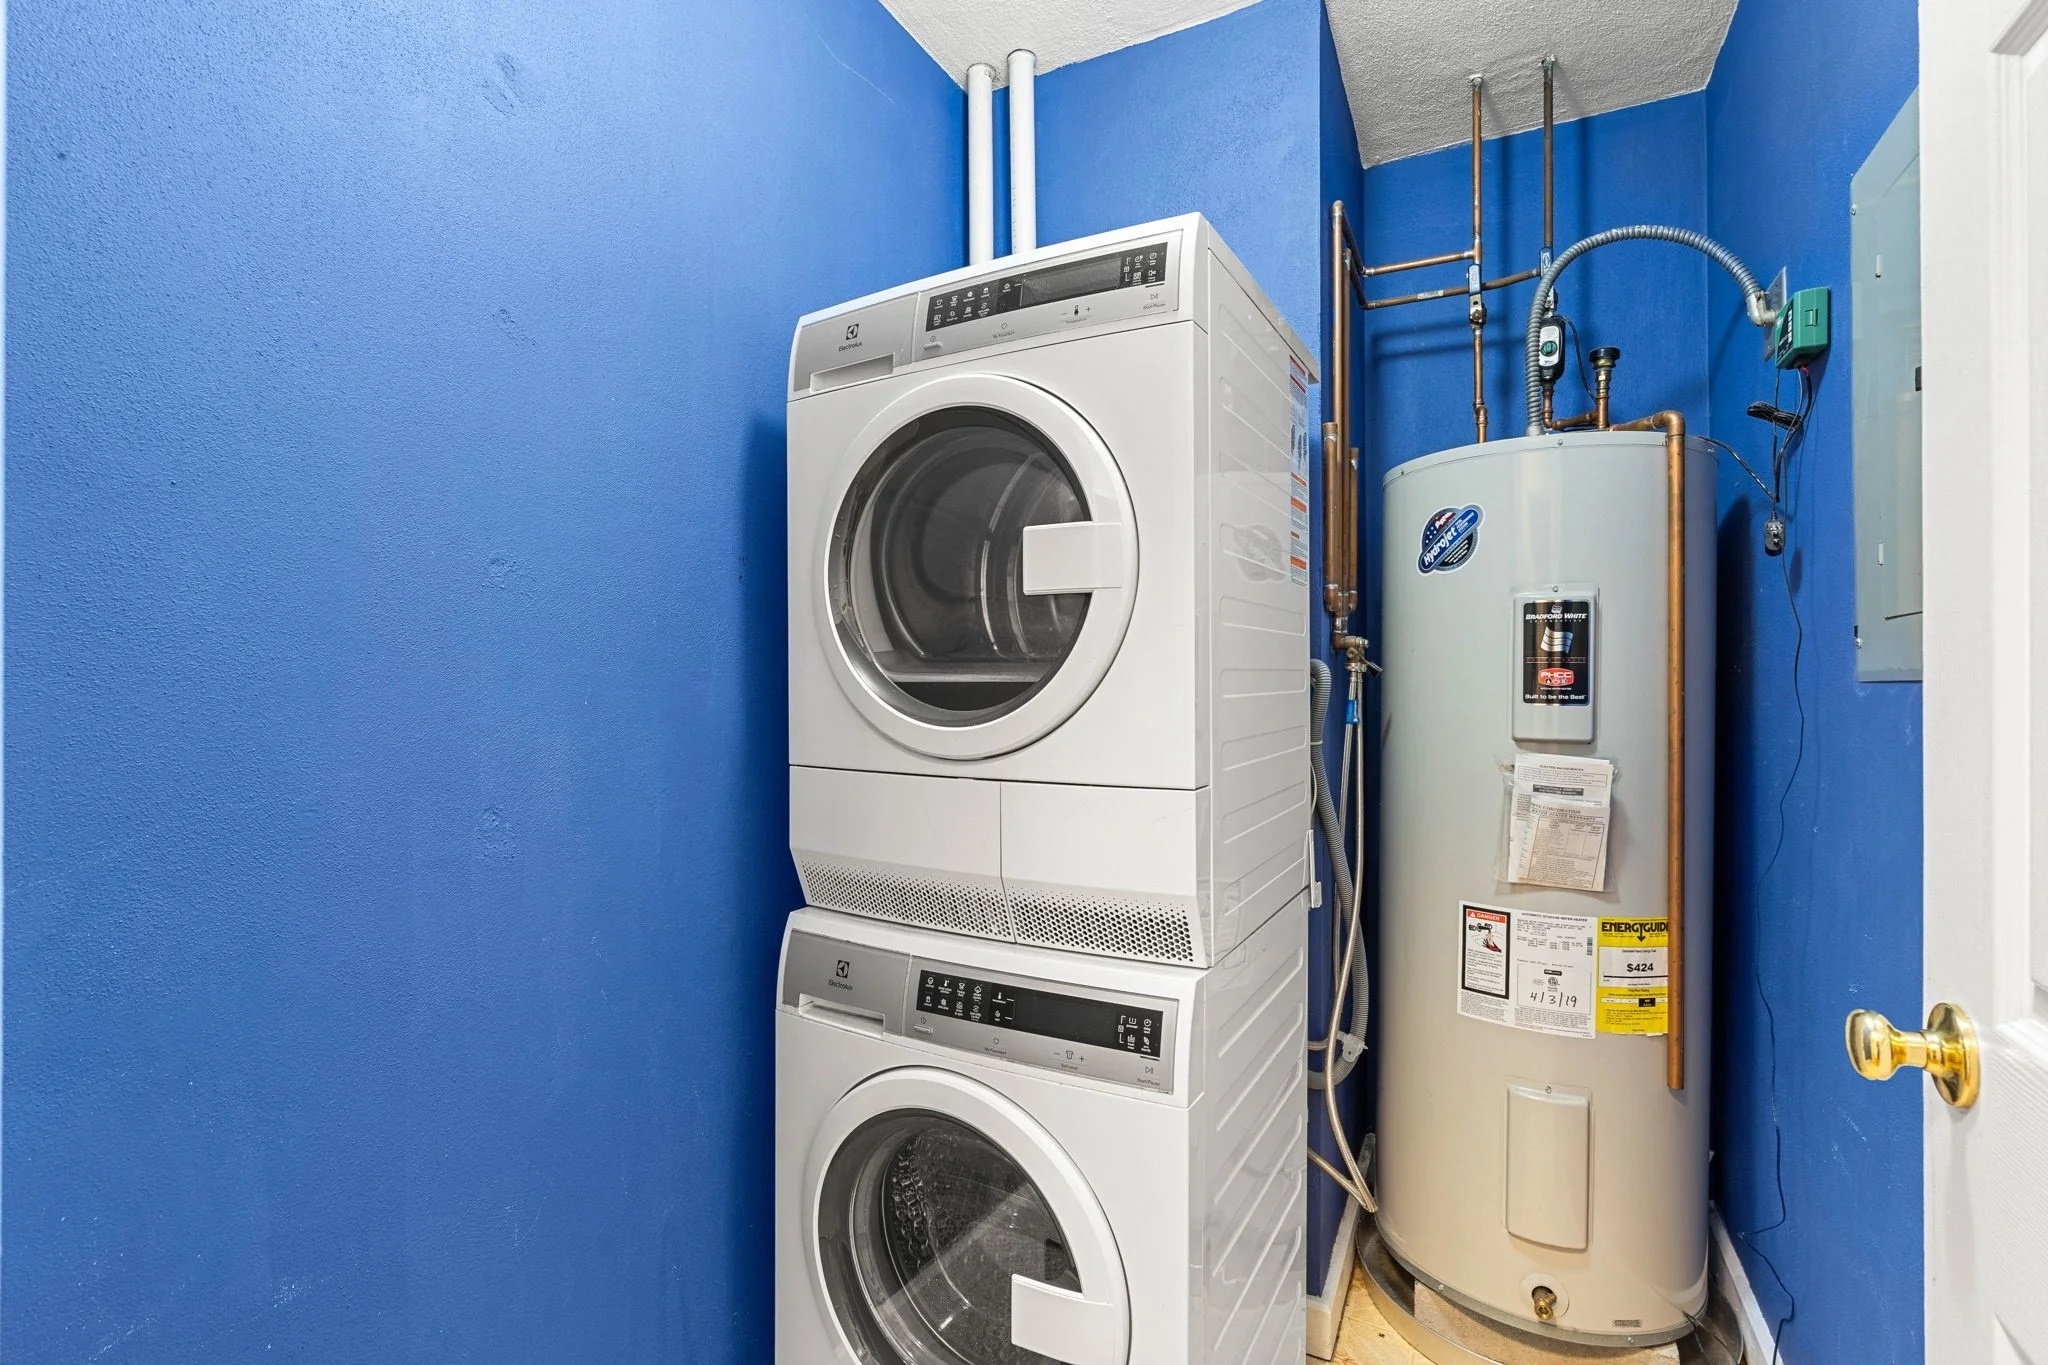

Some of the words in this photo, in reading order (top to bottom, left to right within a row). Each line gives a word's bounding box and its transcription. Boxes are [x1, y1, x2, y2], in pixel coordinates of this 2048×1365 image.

[838, 341, 863, 352] Electrolux
[1423, 525, 1457, 566] Hydrojet
[1476, 912, 1501, 921] DANGER
[1626, 963, 1654, 973] $424
[828, 979, 853, 991] Electrolux
